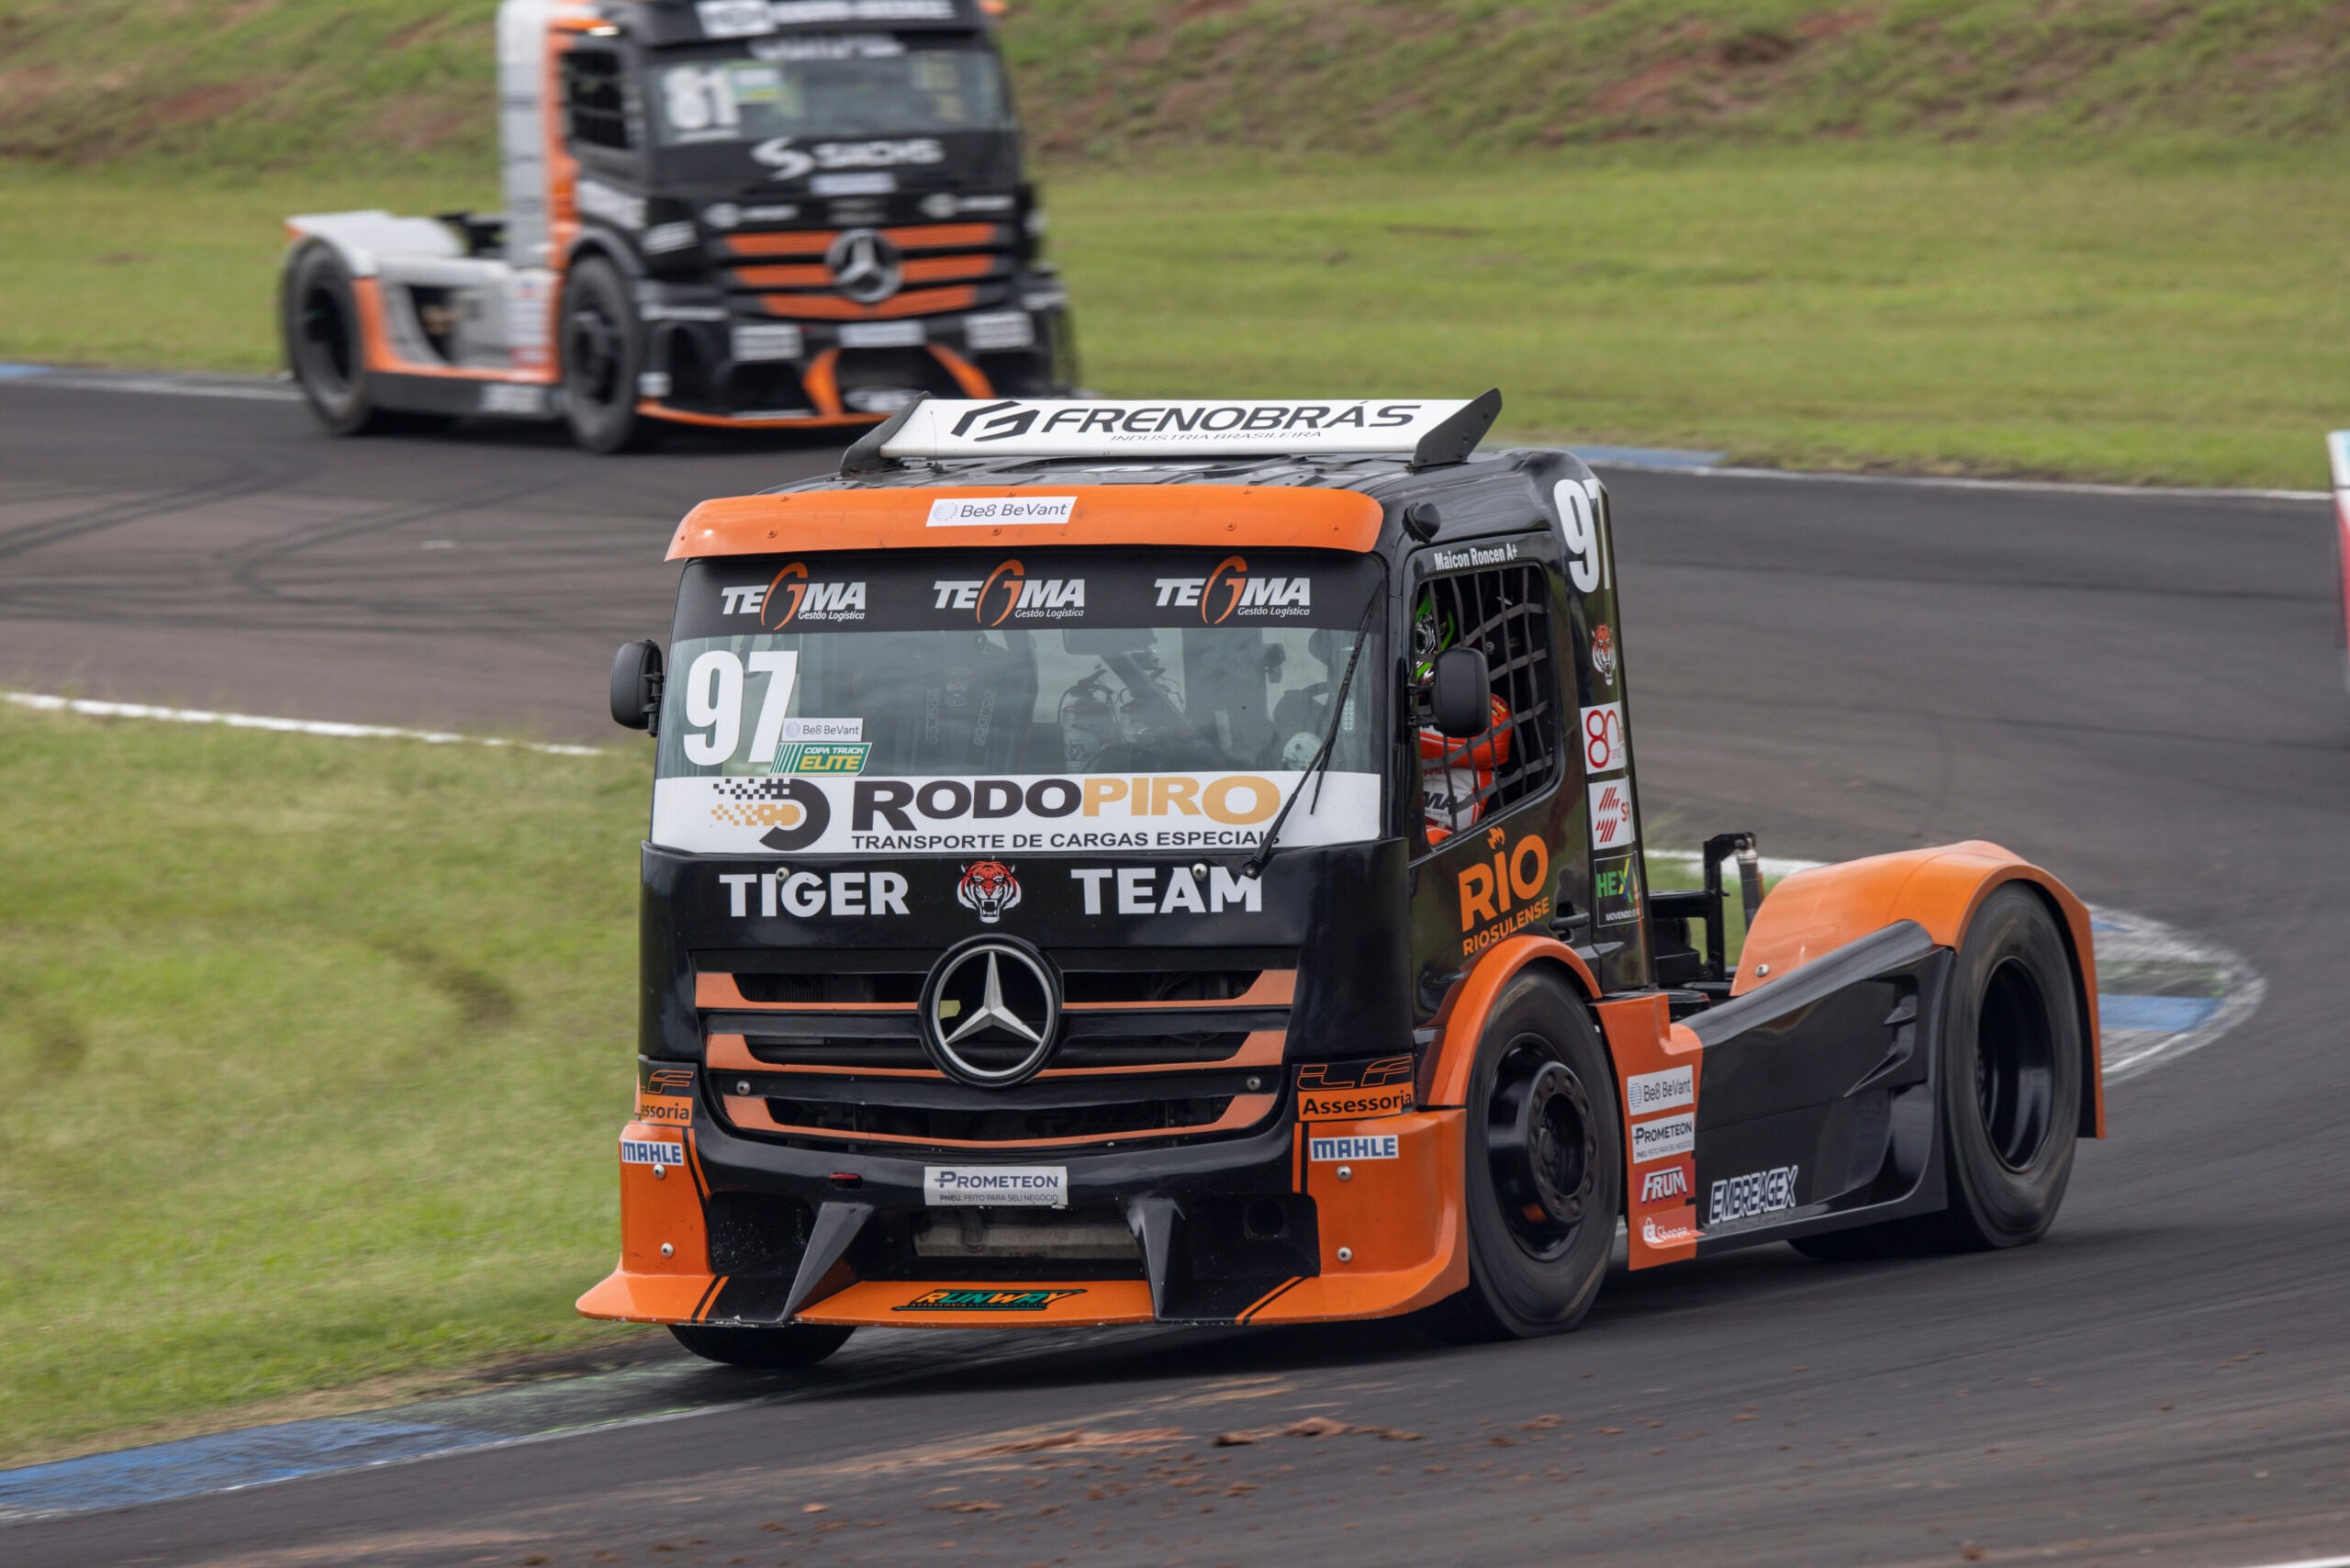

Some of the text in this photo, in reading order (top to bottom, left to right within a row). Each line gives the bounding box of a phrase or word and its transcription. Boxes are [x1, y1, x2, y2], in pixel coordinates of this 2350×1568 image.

[1043, 401, 1422, 434] FRENOBRÁS
[1213, 430, 1322, 441] BRASILEIRA
[959, 501, 1069, 518] Be8 BeVant
[1553, 478, 1611, 593] 97
[1434, 549, 1470, 571] Maicon
[1470, 547, 1505, 567] Roncen
[721, 562, 867, 631] TEGMA
[933, 558, 1085, 627] TEGMA
[1154, 555, 1311, 625] TEGMA
[798, 609, 866, 622] Gestão Logística
[1014, 606, 1085, 621] Gestão Logística
[1237, 604, 1311, 619] Gestão Logística
[683, 649, 799, 766] 97
[802, 724, 859, 735] Be8 BeVant
[799, 755, 862, 770] ELITE
[804, 746, 865, 755] COPA TRUCK
[852, 775, 1281, 832] RODOPIRO
[852, 834, 1005, 850] TRANSPORTE
[1013, 833, 1043, 848] DE
[1049, 832, 1148, 847] CARGAS
[719, 871, 911, 918] TIGER
[1070, 866, 1262, 916] TEAM
[1462, 896, 1550, 957] RIOSULENSE
[640, 1070, 694, 1094] F
[1643, 1078, 1692, 1103] Be8 BeVant
[1302, 1090, 1413, 1115] Assessoria
[1634, 1122, 1693, 1145] PROMETEON
[623, 1141, 682, 1164] MAHLE
[1313, 1137, 1396, 1159] MAHLE
[934, 1170, 1058, 1189] PROMETEON
[1641, 1166, 1688, 1204] FRUM
[1709, 1165, 1798, 1225] EMBREAGEX
[915, 1292, 1073, 1304] RUNWAY
